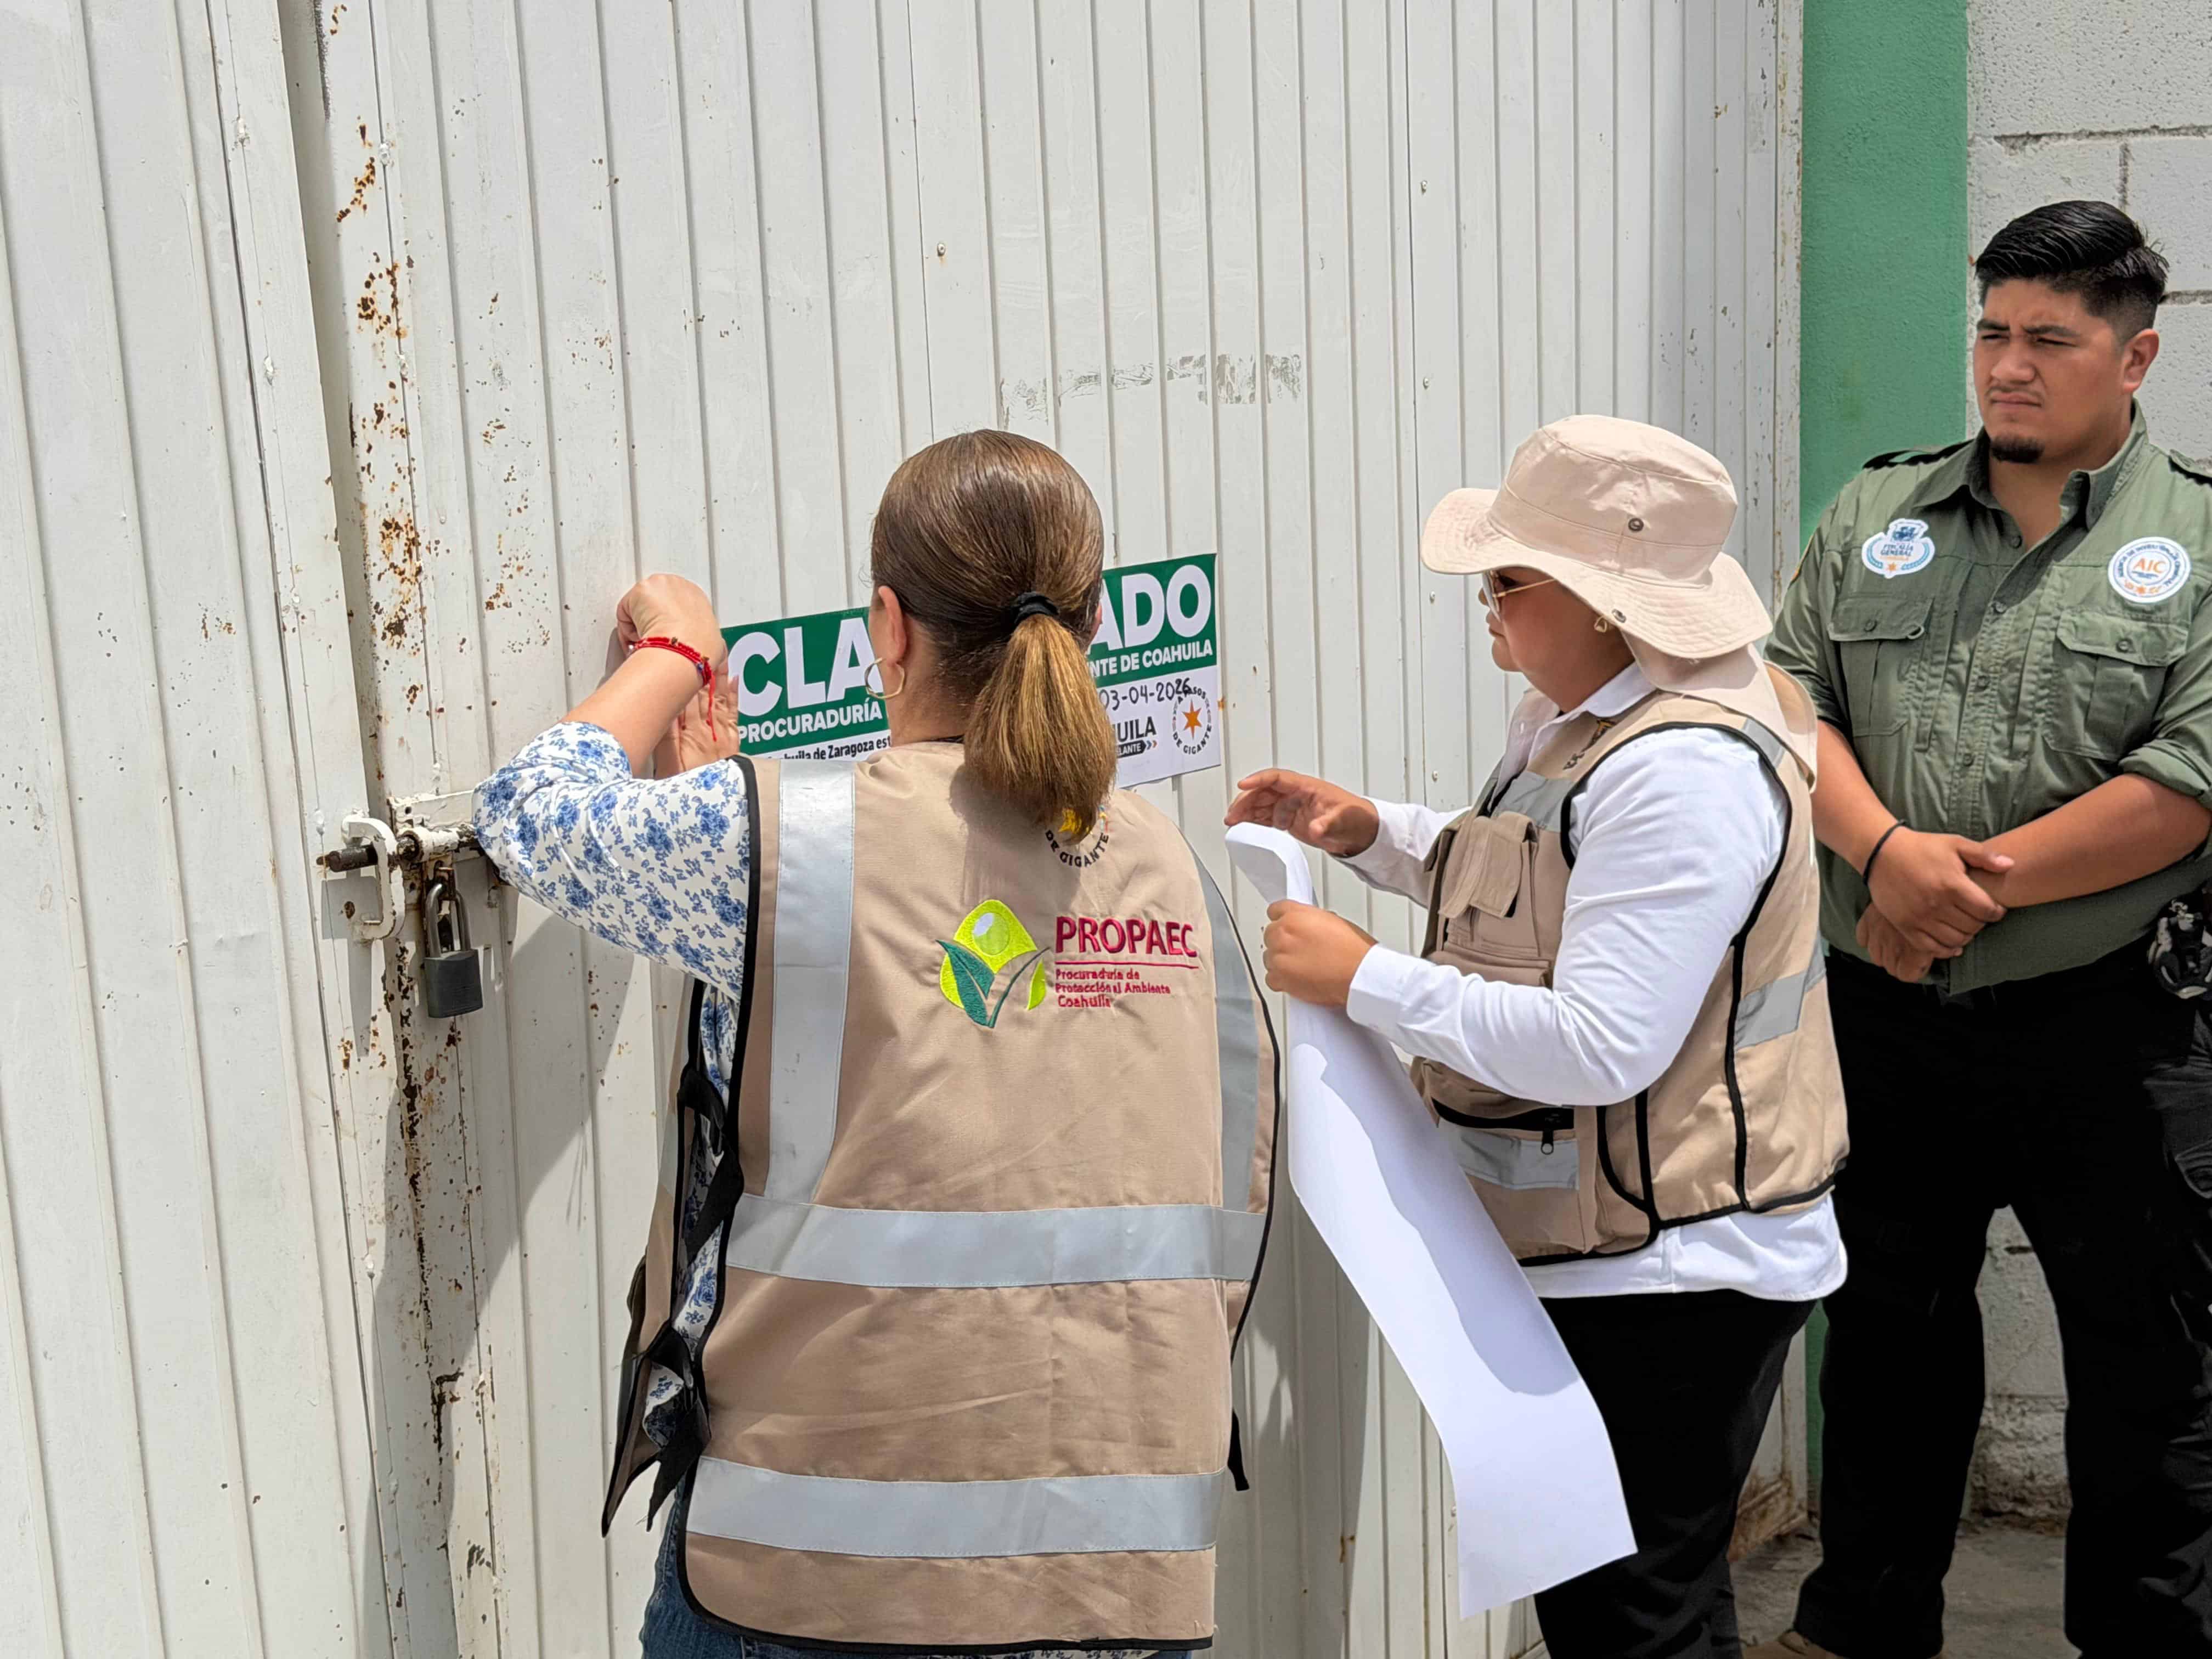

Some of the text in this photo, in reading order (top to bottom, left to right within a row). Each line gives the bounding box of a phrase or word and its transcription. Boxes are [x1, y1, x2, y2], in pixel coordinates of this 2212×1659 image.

[2133, 557, 2166, 574] AIC
[737, 697, 883, 744] PROCURADURÍA
[1120, 652, 1140, 673] DE
[1142, 639, 1213, 668] COAHUILA
[1113, 716, 1156, 742] UILA
[1172, 731, 1183, 748] DE
[1183, 724, 1212, 755] GIGANTE
[814, 749, 826, 760] de
[828, 740, 874, 759] Zaragoza
[1045, 829, 1109, 867] DE GIGANTE
[1056, 916, 1198, 958] PROPAEC
[1126, 968, 1140, 980] de
[1125, 981, 1171, 994] Ambiente
